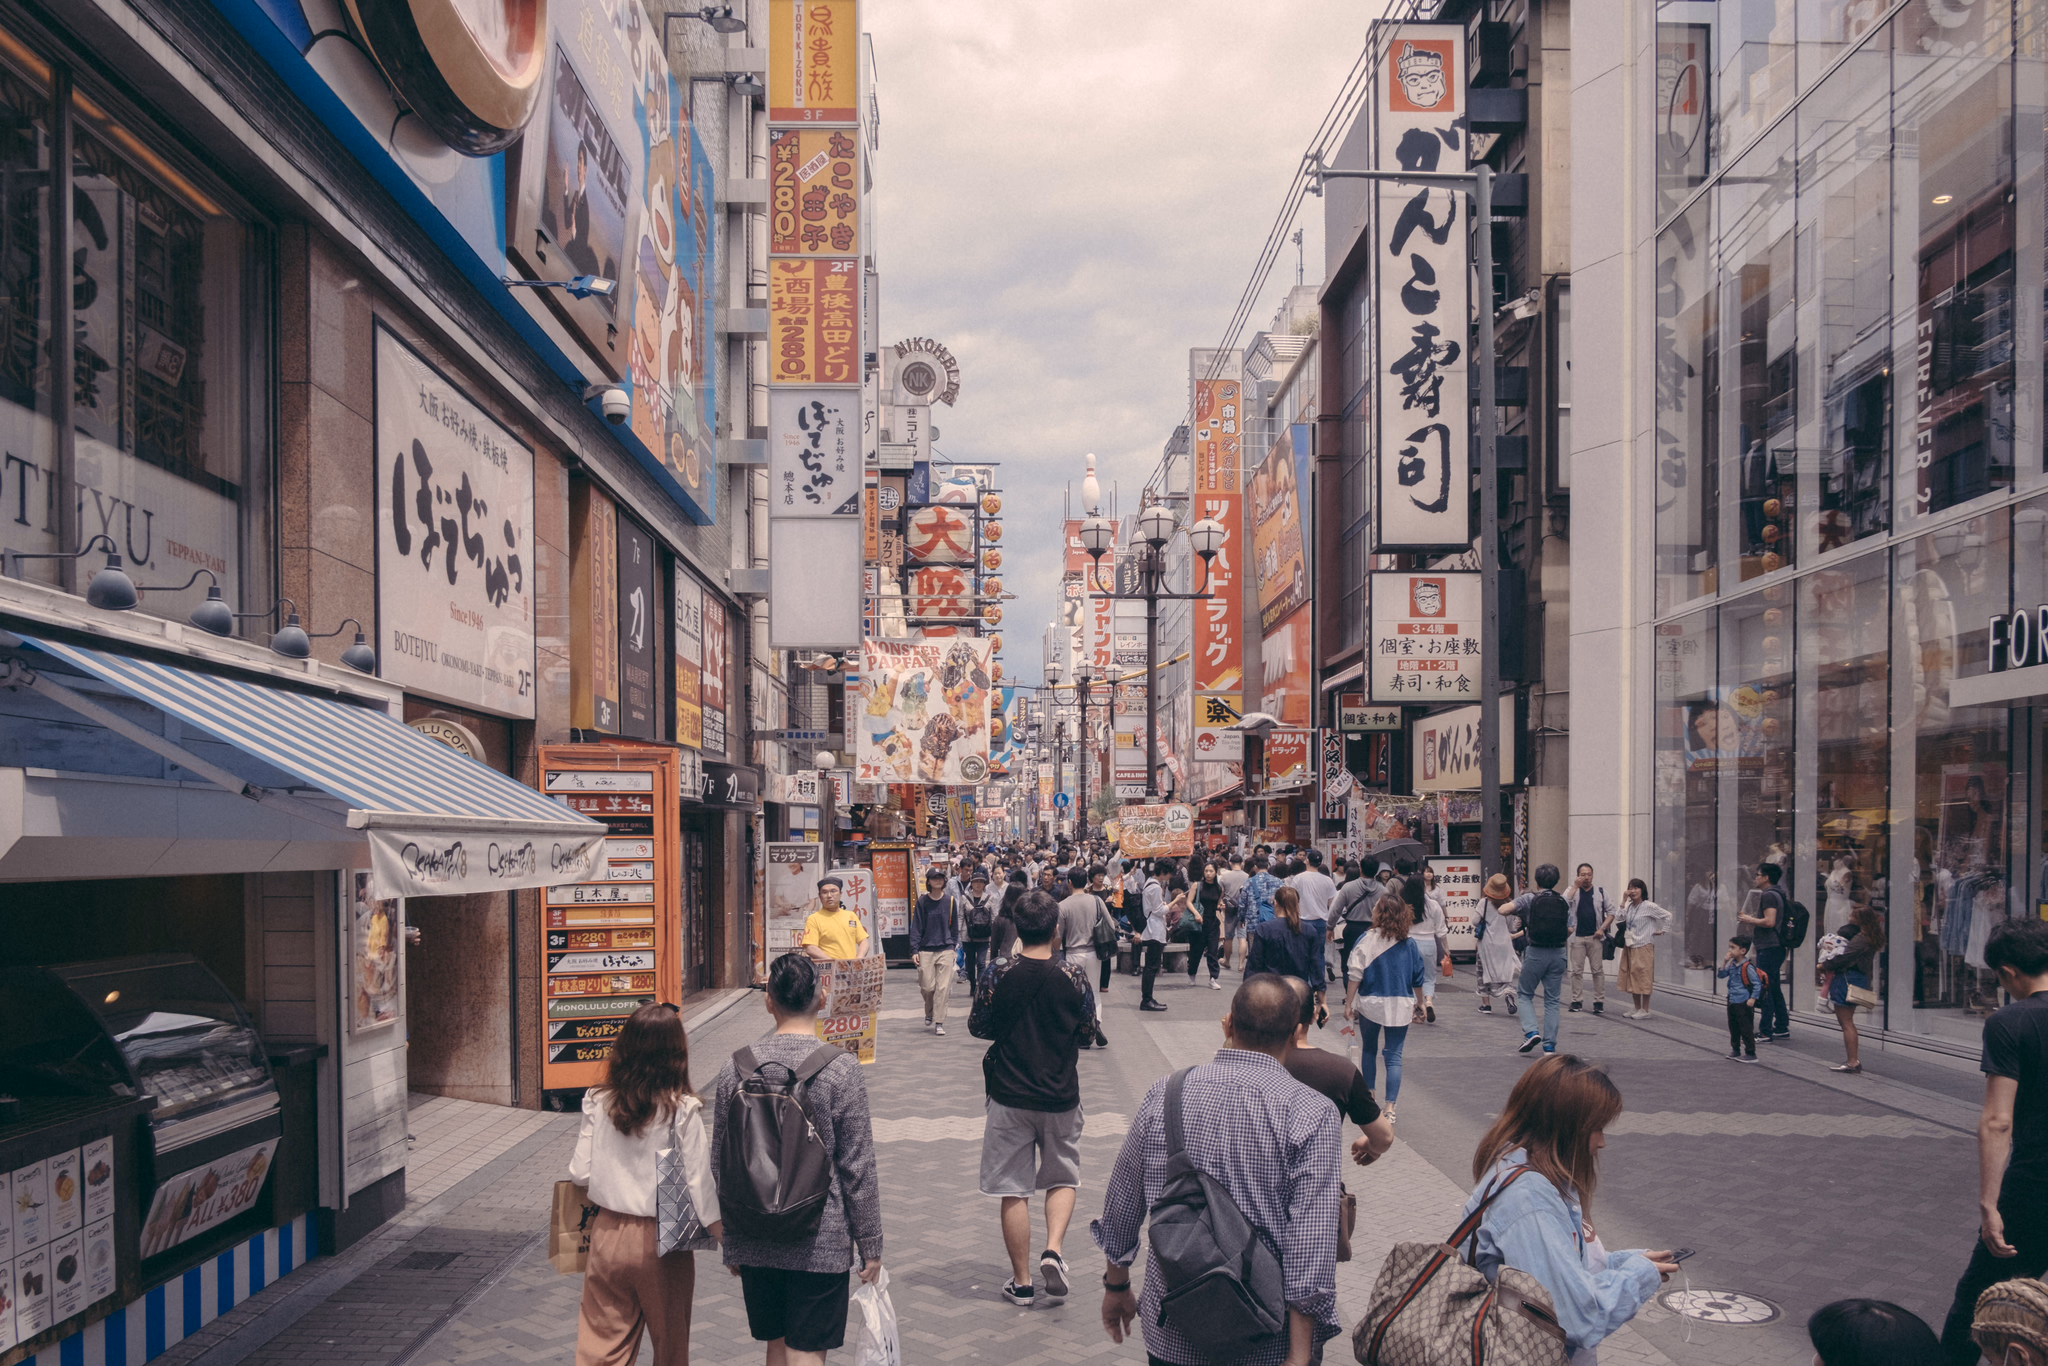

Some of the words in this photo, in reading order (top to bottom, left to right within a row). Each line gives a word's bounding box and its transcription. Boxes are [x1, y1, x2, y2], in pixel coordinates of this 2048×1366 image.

[795, 4, 803, 97] TORIKIZOKU
[771, 131, 783, 140] 3F
[799, 153, 830, 183] 居酒屋
[829, 131, 857, 251] たこやき
[830, 261, 854, 272] 2F
[771, 277, 814, 315] 酒場
[820, 274, 853, 381] 豊後高田どり
[780, 326, 806, 374] 280
[909, 371, 929, 388] NK
[418, 384, 440, 423] 大阪
[836, 418, 845, 435] 大阪
[798, 400, 839, 505] ぼてぢゅう
[843, 504, 858, 513] 2F
[392, 438, 523, 609] ぼてぢゅう
[166, 539, 226, 574] TEPPAN-YAKI
[1412, 624, 1445, 635] 3・4階
[394, 630, 437, 663] BOTEJYU
[864, 640, 941, 657] MONSTER
[1379, 637, 1482, 656] 個室・お座敷
[867, 654, 941, 672] PARFAIT
[1399, 660, 1457, 671] 地階・1・2階
[517, 669, 531, 697] 2F
[1389, 673, 1472, 693] 寿司・和食
[629, 692, 647, 709] GRILL
[601, 701, 611, 726] 3F
[1342, 711, 1398, 726] 個室・和食
[1272, 734, 1305, 744] ツルハ
[1272, 747, 1299, 755] ドラッグ
[860, 764, 881, 779] 2F
[1325, 733, 1342, 814] 大阪みげ
[702, 773, 715, 795] 7F
[771, 852, 815, 862] マッサージ
[574, 887, 620, 899] 白木屋
[550, 935, 565, 945] 3F
[603, 955, 643, 967] ぼてぢゅう
[557, 1003, 608, 1011] HONOLULU
[186, 1199, 216, 1231] ALL
[216, 1175, 260, 1217] ¥380
